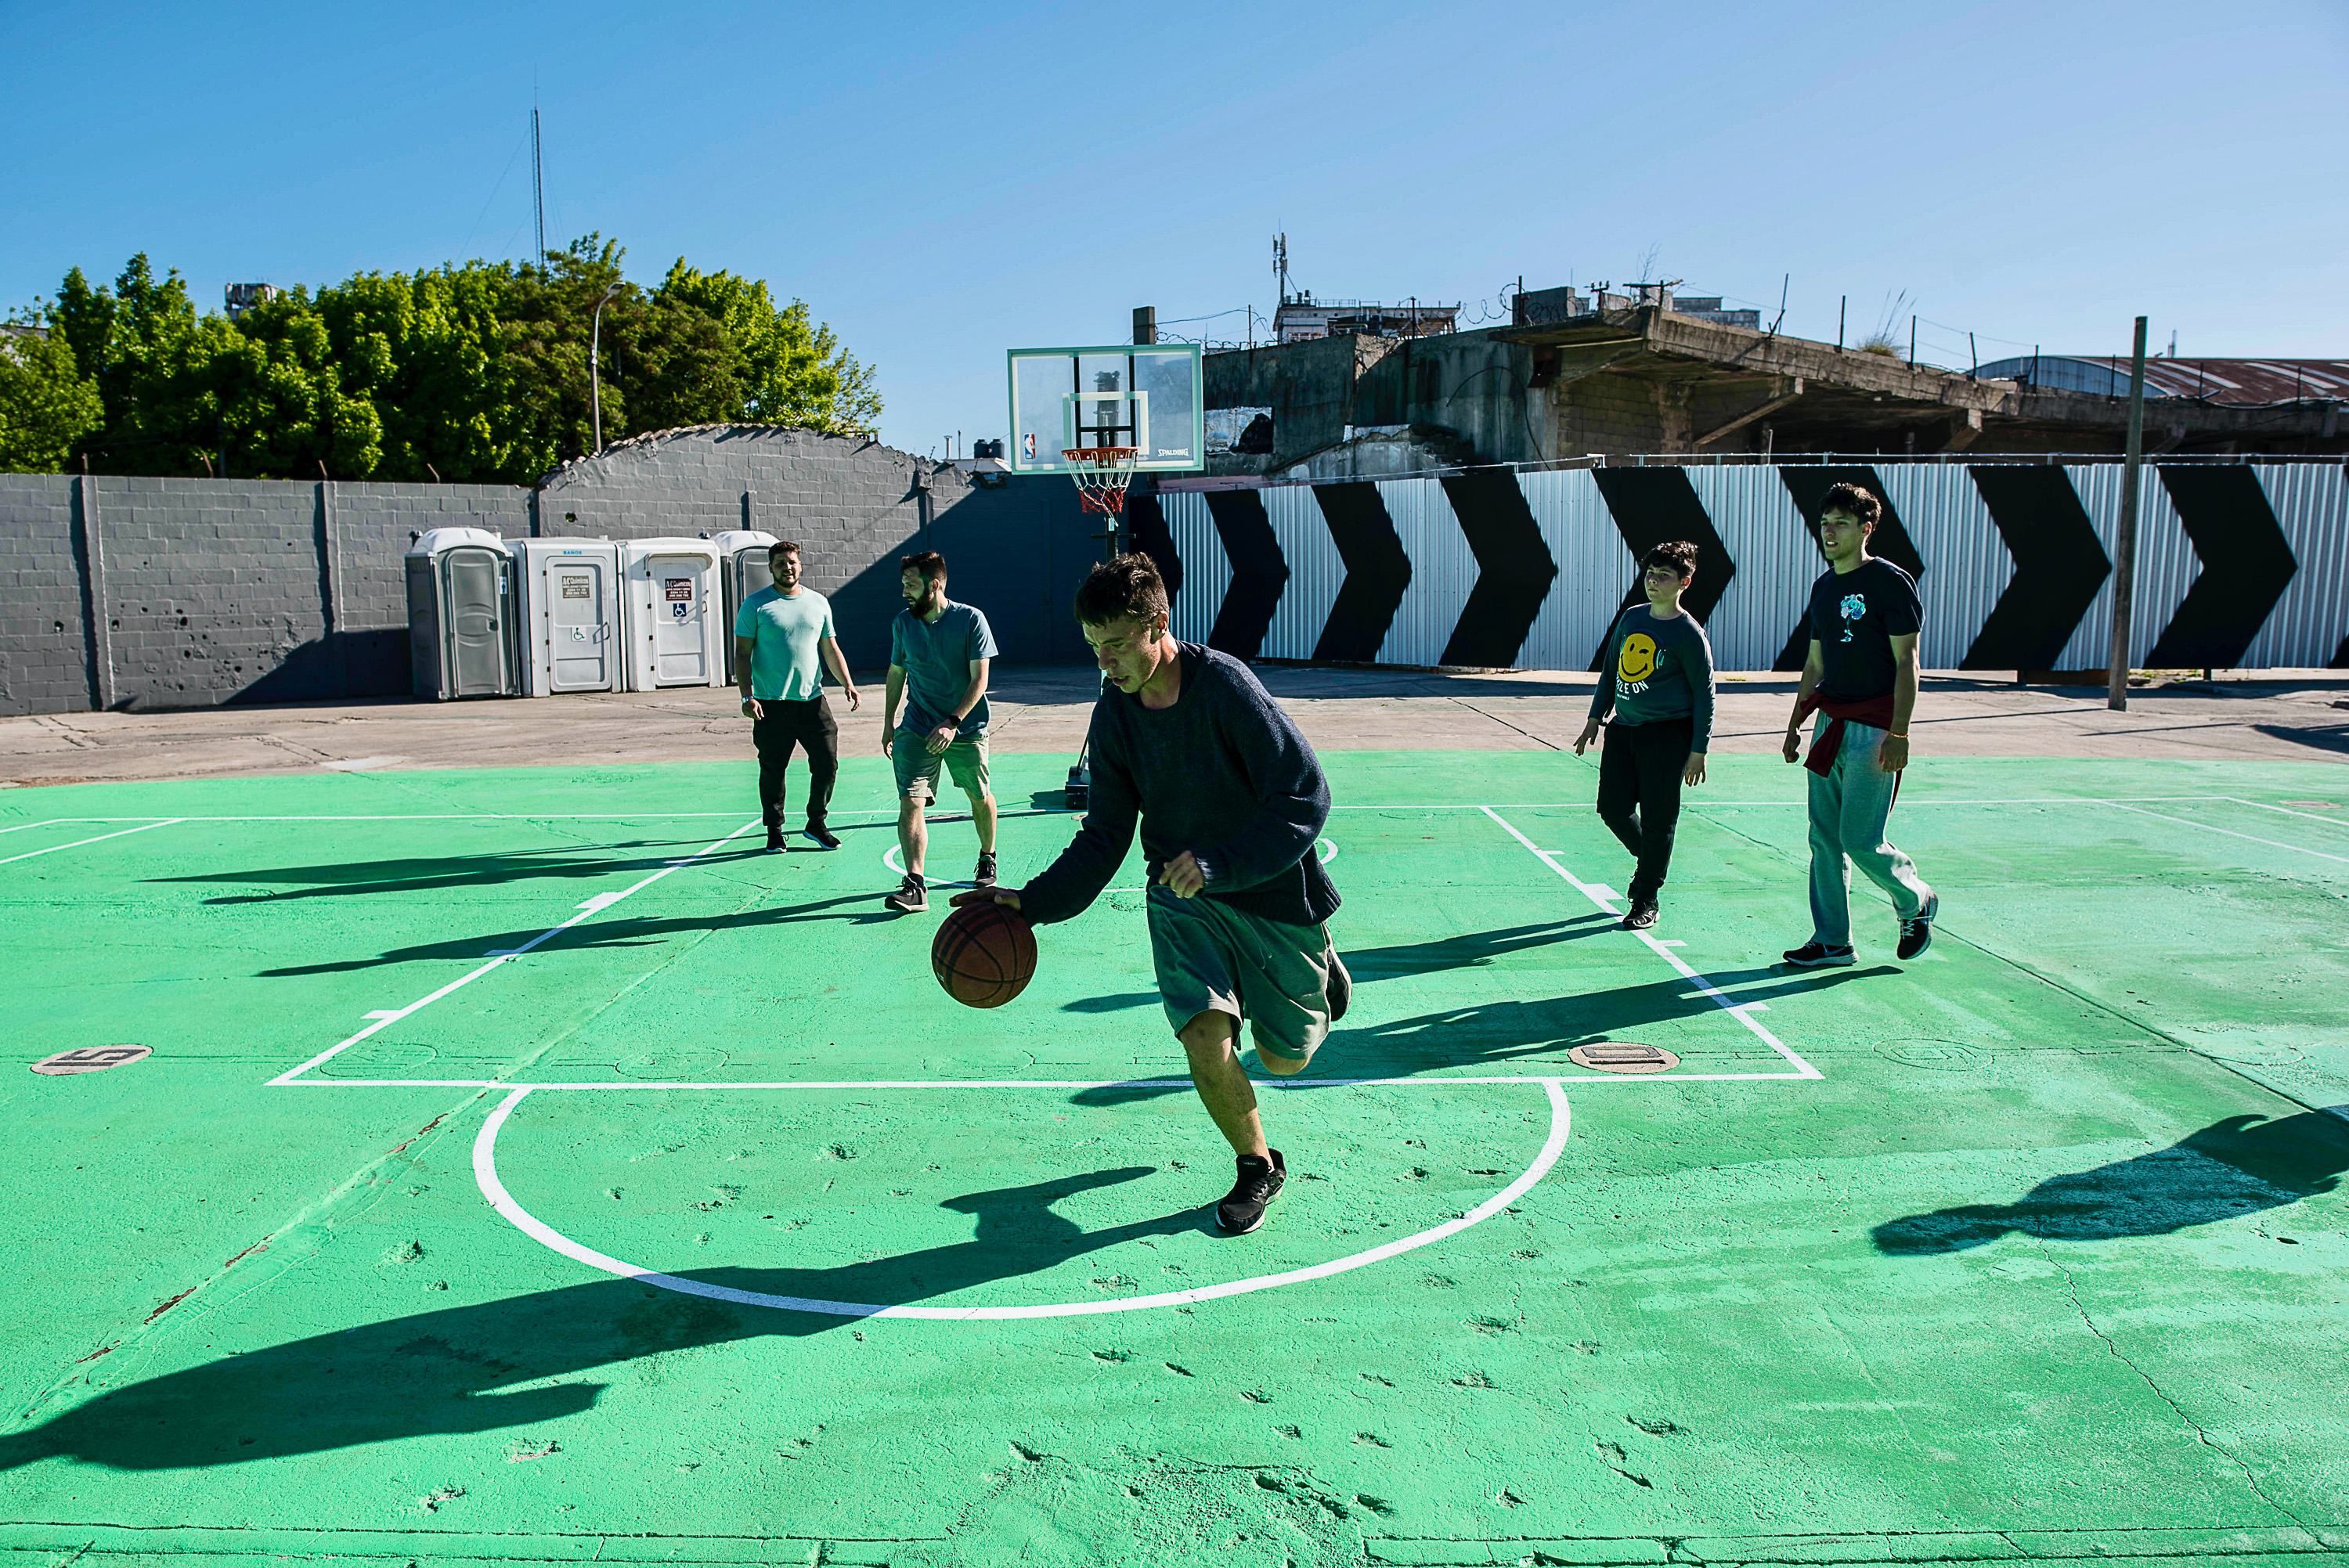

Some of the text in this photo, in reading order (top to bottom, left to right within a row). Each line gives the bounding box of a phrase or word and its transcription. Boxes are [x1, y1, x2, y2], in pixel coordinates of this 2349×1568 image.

[1158, 448, 1189, 457] SPALDING
[1632, 680, 1649, 694] ON
[42, 1049, 146, 1066] 15
[1581, 1047, 1666, 1065] 10
